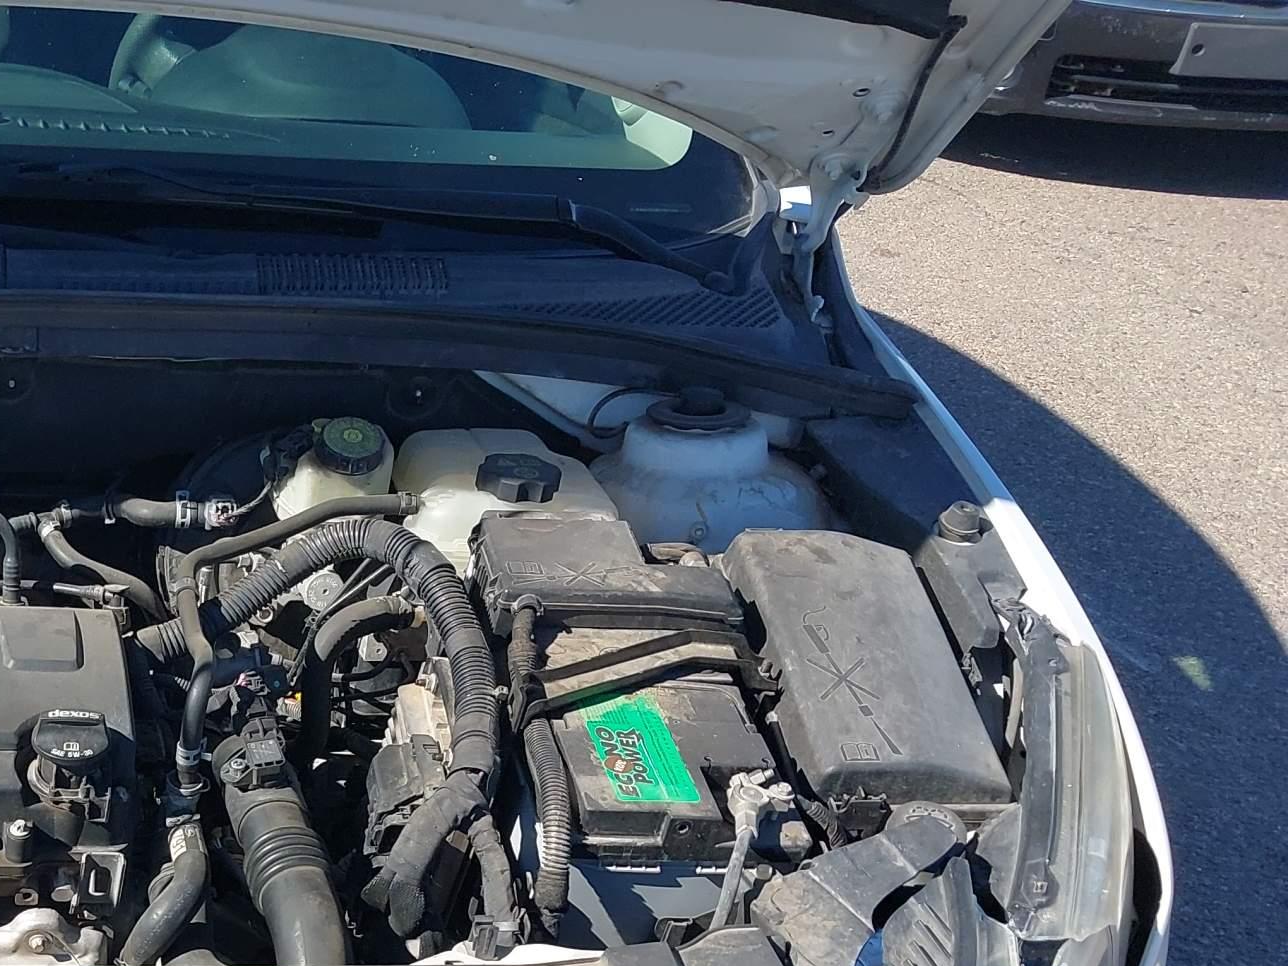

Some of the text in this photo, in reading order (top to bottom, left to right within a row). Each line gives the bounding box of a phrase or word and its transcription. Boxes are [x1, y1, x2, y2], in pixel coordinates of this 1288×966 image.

[48, 709, 100, 719] dexos
[51, 748, 66, 757] SAE
[615, 728, 655, 784] POWER
